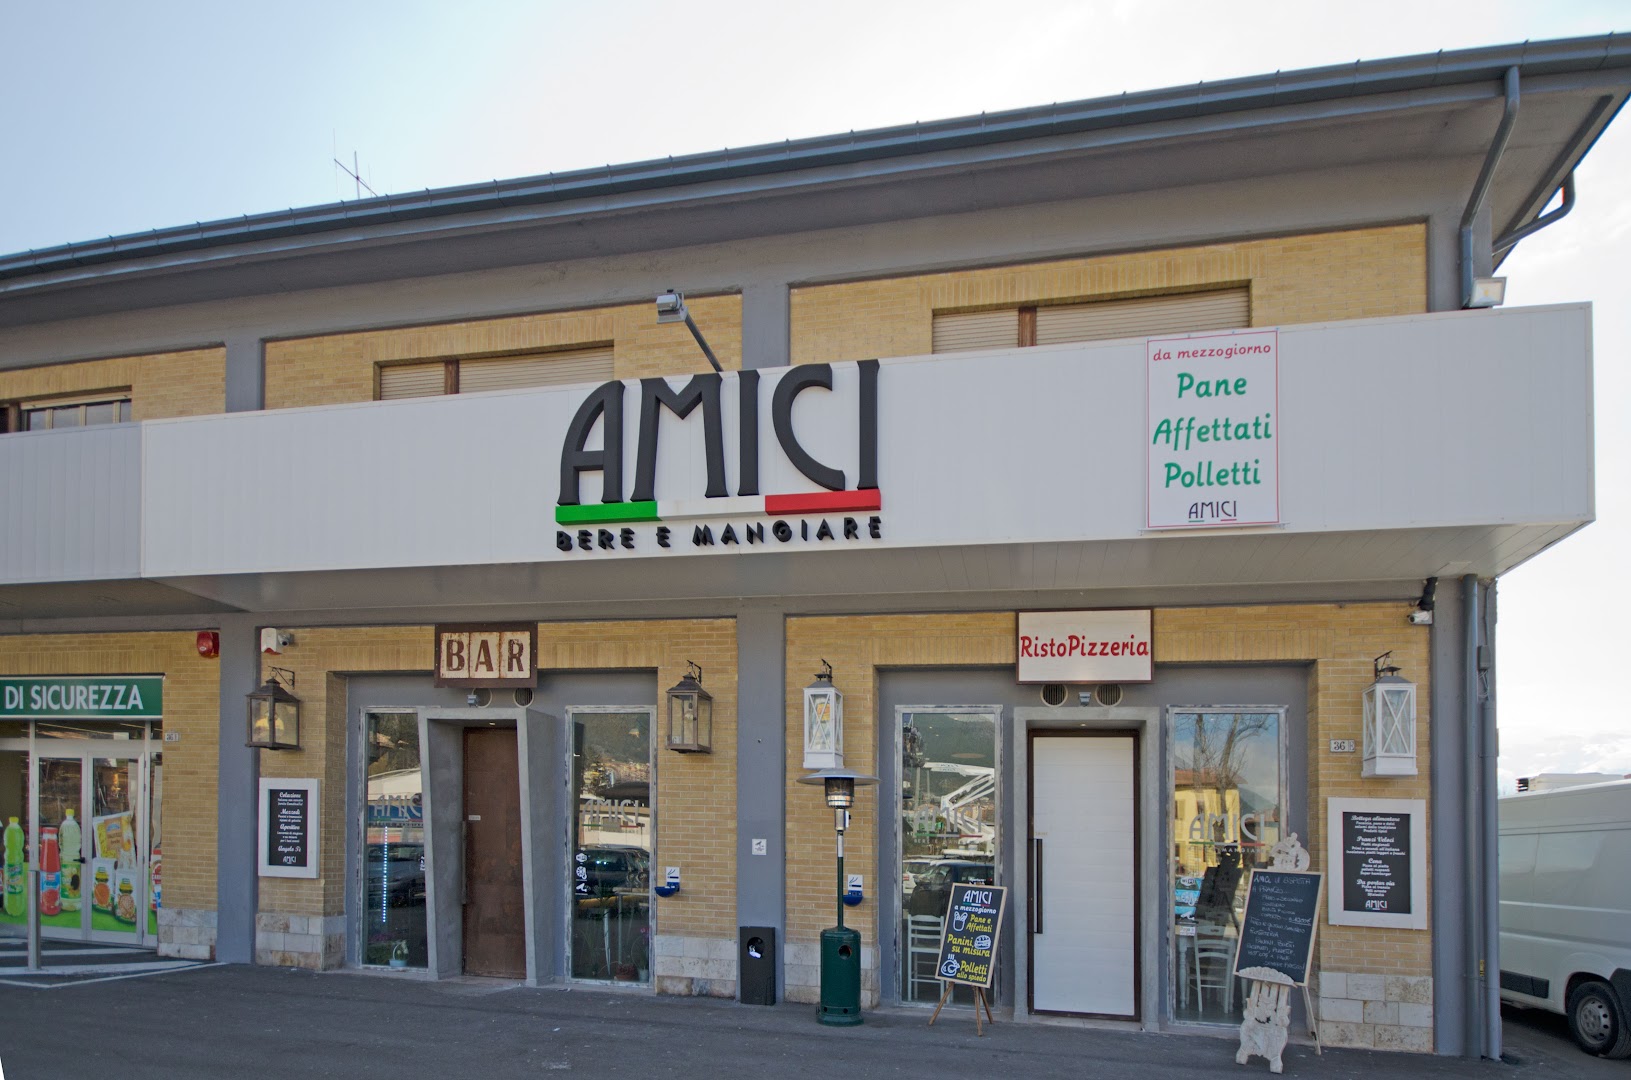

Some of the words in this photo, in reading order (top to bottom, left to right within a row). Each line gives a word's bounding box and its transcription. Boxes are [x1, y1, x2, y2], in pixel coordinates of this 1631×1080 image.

[1153, 348, 1172, 361] da
[1177, 343, 1271, 359] mezzogiorno
[1177, 372, 1247, 398] Pane
[556, 359, 881, 506] AMICI
[1152, 412, 1272, 451] Affettati
[1164, 459, 1261, 488] Polletti
[1188, 500, 1237, 519] AMICI
[556, 527, 636, 552] BERE
[656, 526, 671, 548] E
[692, 516, 882, 546] MANGIARE
[446, 639, 524, 672] BAR
[1020, 634, 1149, 657] RistoPizzeria
[5, 685, 24, 709] DI
[30, 684, 144, 710] SICUREZZA
[1333, 741, 1346, 751] 36
[374, 795, 422, 817] AMIC
[582, 799, 639, 823] AMICI
[914, 806, 982, 833] AMICI
[1189, 812, 1265, 840] AMICI
[963, 890, 992, 904] AMICI
[1365, 900, 1387, 909] AMICI
[960, 905, 996, 914] mezzogiorno
[970, 914, 986, 924] Pane
[966, 923, 992, 932] Affettati
[947, 934, 974, 946] Panini
[962, 945, 990, 957] misura
[960, 960, 988, 975] Polletti
[969, 973, 986, 982] spiedo
